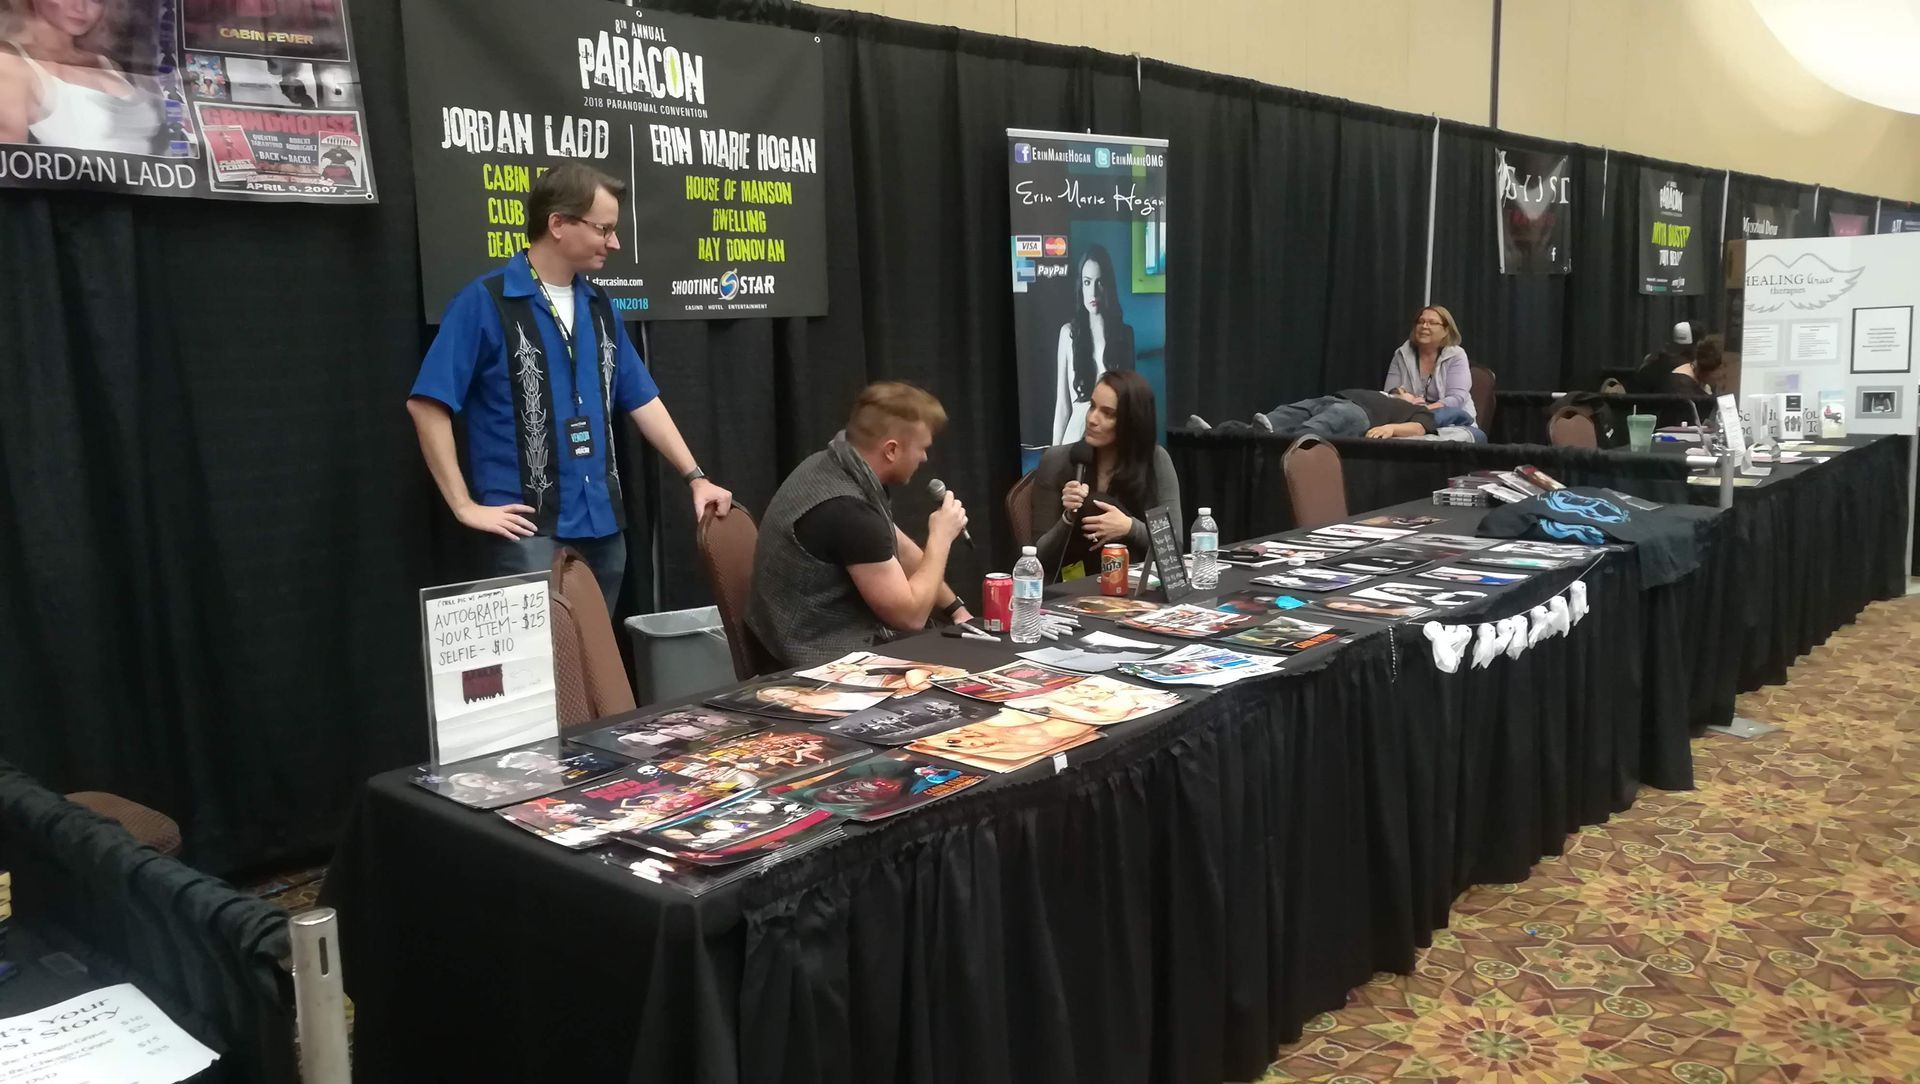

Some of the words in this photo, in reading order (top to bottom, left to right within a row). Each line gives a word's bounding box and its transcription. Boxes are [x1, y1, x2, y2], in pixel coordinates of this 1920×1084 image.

[219, 27, 265, 41] CABIN
[267, 31, 315, 45] FEVER
[631, 22, 667, 42] ANNUAL
[578, 30, 705, 105] PARACON
[583, 96, 604, 108] 2018
[607, 98, 659, 114] PARANORMAL
[660, 105, 709, 119] CONVENTION
[441, 106, 534, 155] JORDAN
[544, 115, 610, 159] LADD
[259, 151, 280, 162] BACK
[649, 124, 694, 166] ERIN
[700, 129, 751, 171] MARIE
[757, 133, 817, 174] HOGAN
[1032, 146, 1091, 164] ErinMarieHogan
[1111, 151, 1164, 167] ErinMarieOMG
[0, 149, 117, 185] JORDAN
[121, 157, 197, 190] LADD
[483, 163, 531, 193] CABIN
[246, 182, 286, 193] APRIL
[303, 185, 338, 194] 2007
[685, 175, 721, 202] HOUSE
[723, 178, 738, 202] OF
[741, 179, 793, 205] MANSON
[1015, 180, 1053, 205] Erin
[1058, 178, 1106, 209] Marie
[1113, 183, 1165, 216] Hogan
[487, 197, 526, 226] CLUB
[712, 208, 767, 234] DWELLING
[698, 237, 721, 262] RAY
[726, 238, 786, 263] DONOVAN
[1022, 242, 1038, 250] VISA
[1037, 264, 1069, 278] PayPal
[671, 277, 719, 295] SHOOTING
[739, 275, 775, 295] STAR
[708, 303, 724, 311] HOTEL
[728, 303, 768, 311] ENTERTAINMENT
[521, 590, 545, 611] $25
[435, 626, 473, 648] YOUR
[521, 610, 546, 631] $25
[491, 637, 515, 656] $10
[39, 998, 110, 1025] Your
[40, 1006, 121, 1039] Story
